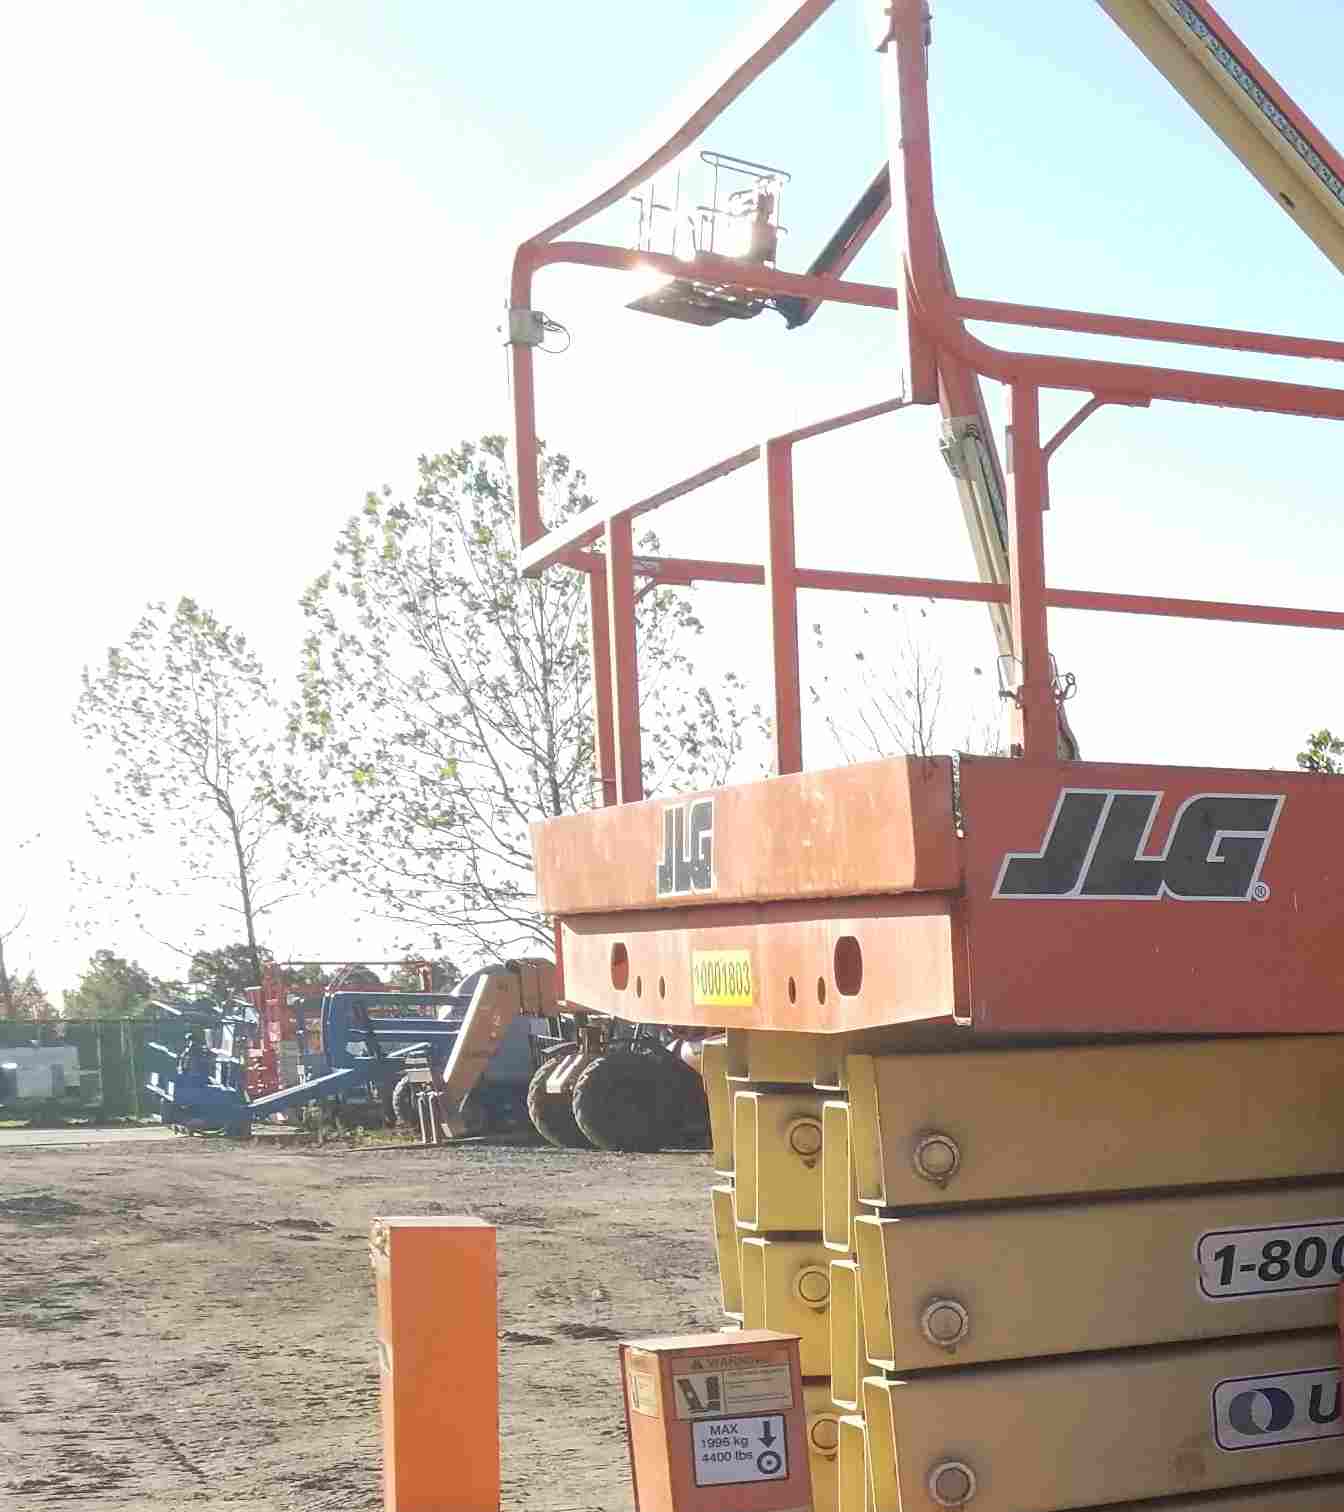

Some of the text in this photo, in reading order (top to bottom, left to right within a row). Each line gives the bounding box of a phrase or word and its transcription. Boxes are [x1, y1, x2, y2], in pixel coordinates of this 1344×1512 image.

[656, 799, 716, 896] JLG
[992, 787, 1286, 901] JLG
[710, 1424, 738, 1435] MAX
[733, 1436, 749, 1449] kg
[702, 1450, 753, 1462] 4400 lbs
